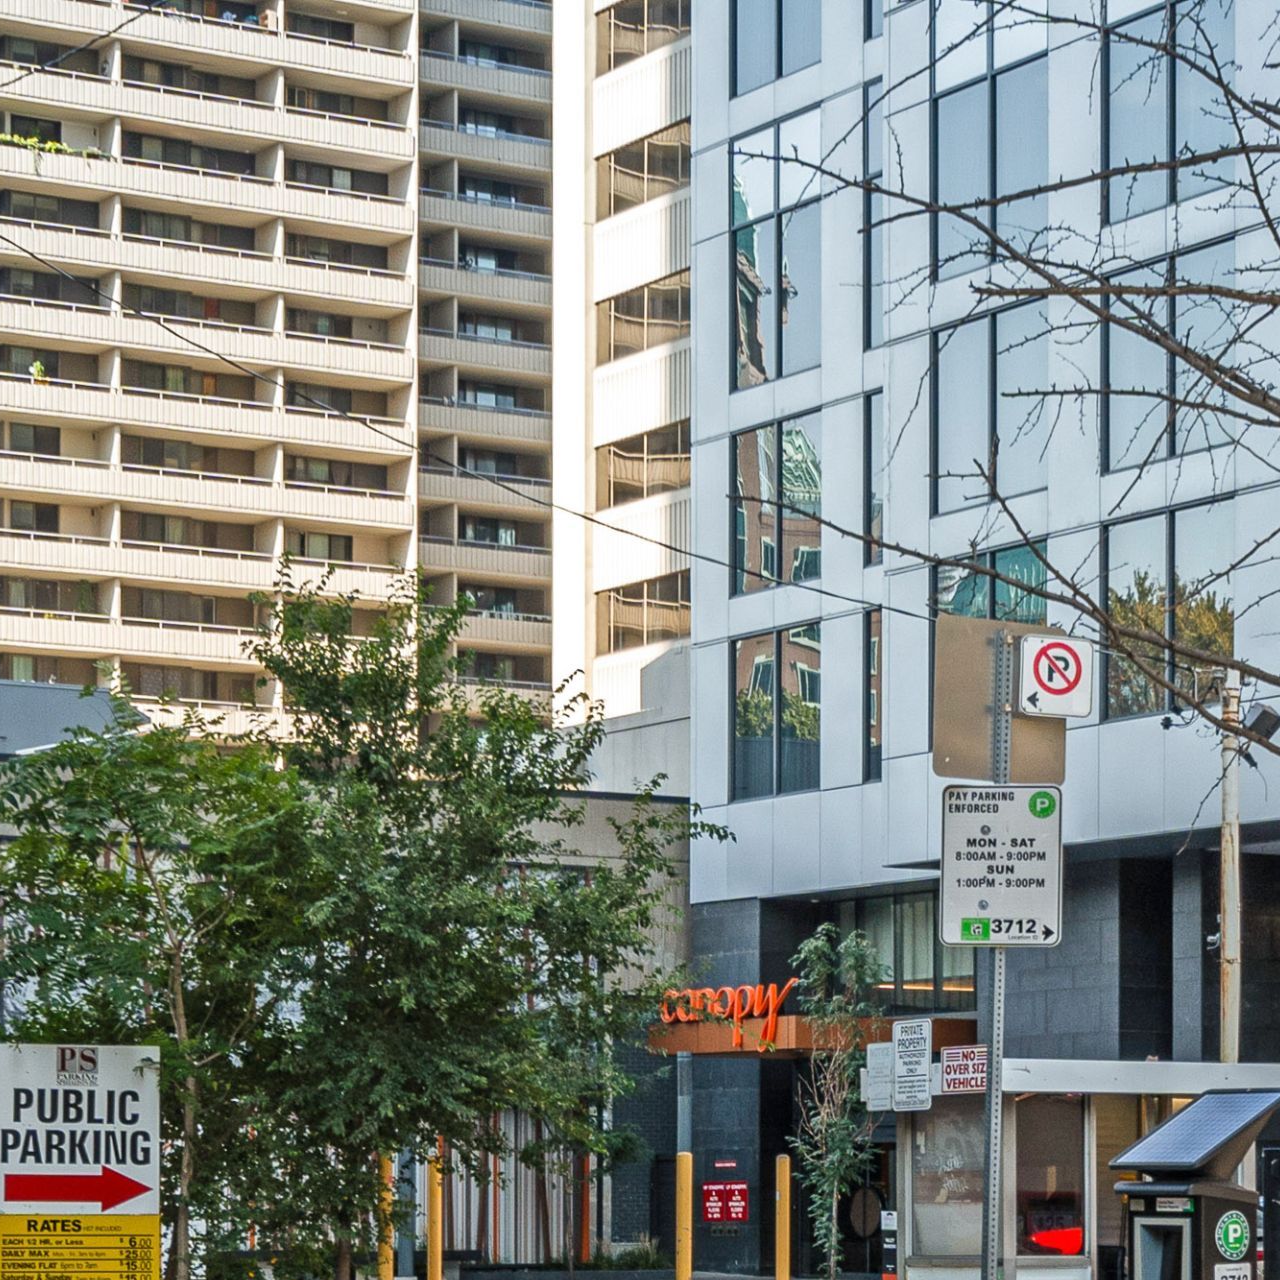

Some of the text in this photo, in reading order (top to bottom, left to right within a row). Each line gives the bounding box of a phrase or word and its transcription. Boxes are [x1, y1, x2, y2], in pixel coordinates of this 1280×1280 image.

[949, 792, 1014, 801] PAY PARKING
[948, 804, 998, 814] ENFORCED
[966, 838, 996, 847] MON
[1010, 838, 1036, 847] SAT
[955, 852, 996, 861] 8:00AM
[1006, 852, 1046, 861] 9:00PM
[986, 865, 1014, 874] SUN
[956, 878, 995, 888] 1:00PM
[1005, 878, 1045, 888] 9:00PM
[992, 920, 1036, 934] 3712
[658, 977, 799, 1052] canopy
[900, 1024, 924, 1036] PRIVATE
[898, 1037, 927, 1050] PROPERTY
[58, 1047, 98, 1072] PS
[962, 1050, 976, 1062] NO
[945, 1062, 986, 1075] OVER SIZ
[946, 1076, 986, 1090] VEHICLE
[13, 1088, 140, 1125] PUBLIC
[0, 1128, 151, 1165] PARKING
[27, 1220, 82, 1232] RATES
[2, 1262, 36, 1270] EVENING
[38, 1262, 57, 1270] FLAT
